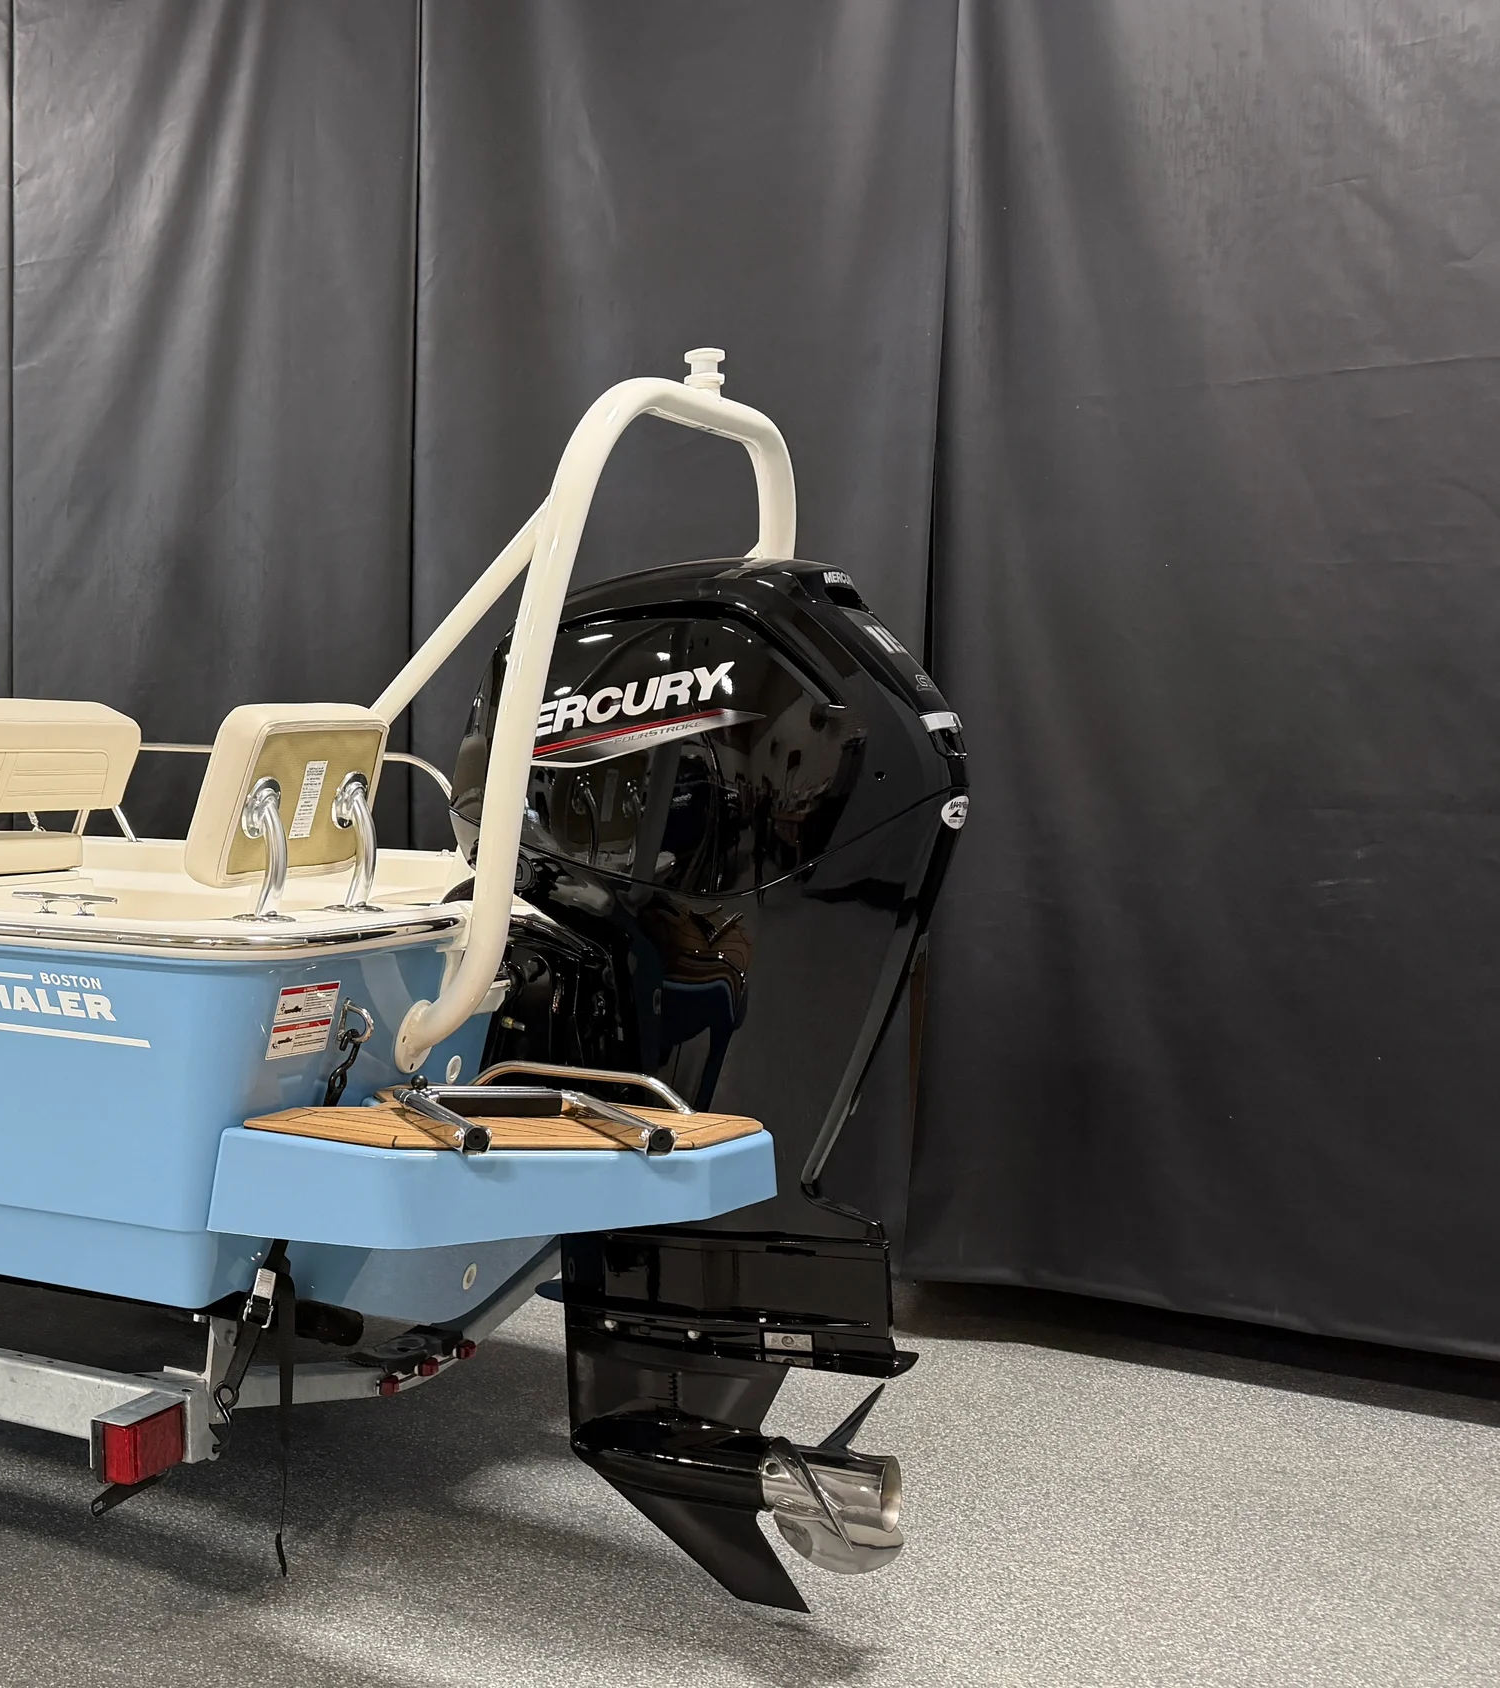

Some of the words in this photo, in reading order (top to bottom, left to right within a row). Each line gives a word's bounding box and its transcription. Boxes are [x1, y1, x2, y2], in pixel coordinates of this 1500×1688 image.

[822, 571, 854, 585] MERCU
[536, 661, 735, 737] ERCURY
[613, 720, 703, 745] FOURSTROKE
[39, 971, 102, 990] BOSTON
